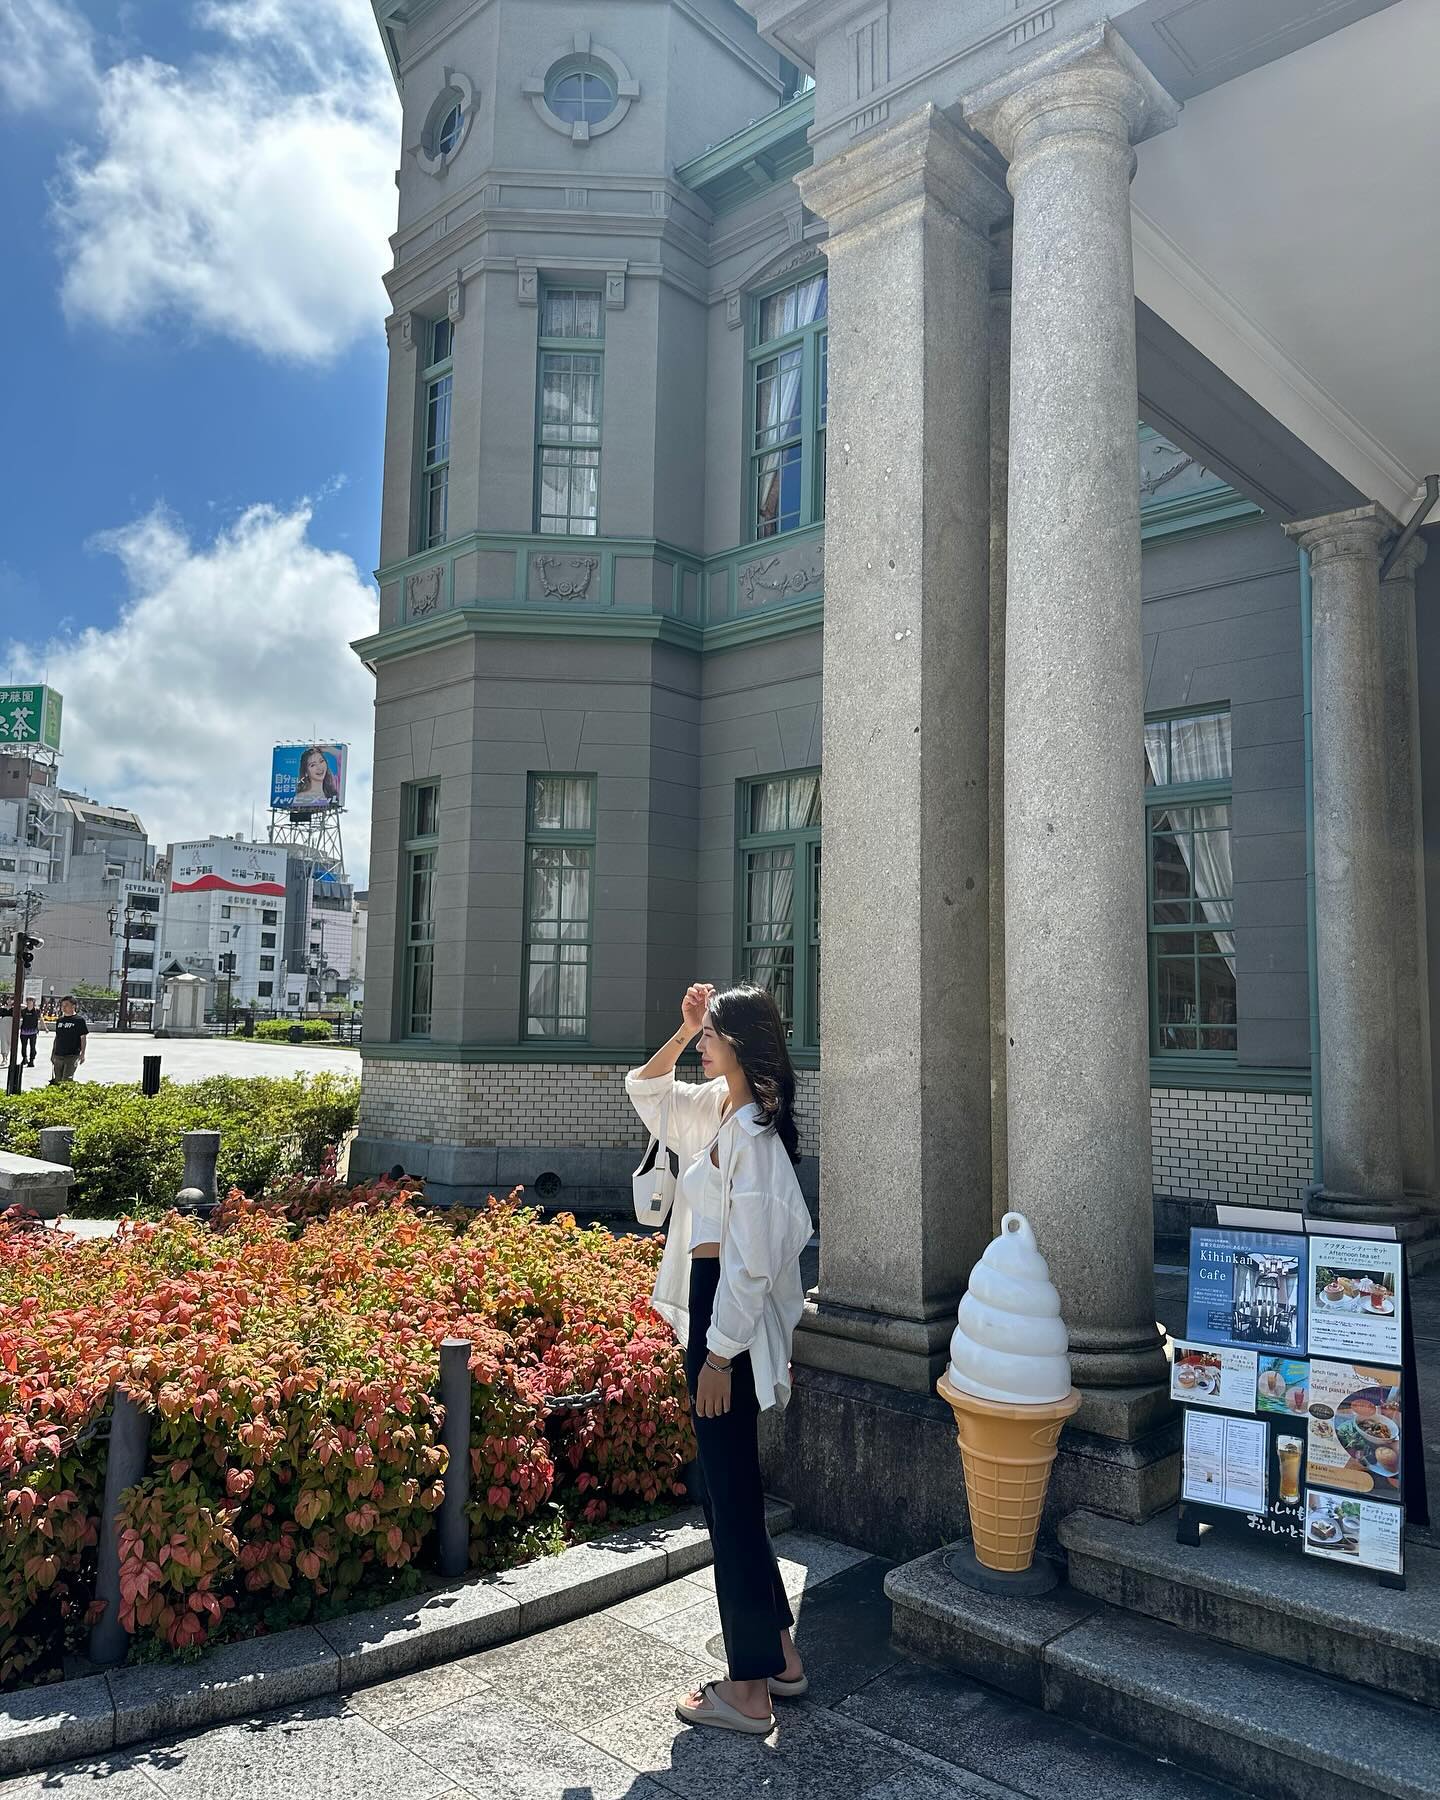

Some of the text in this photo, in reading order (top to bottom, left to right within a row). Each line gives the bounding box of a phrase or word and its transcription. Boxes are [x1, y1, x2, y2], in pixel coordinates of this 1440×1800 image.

[124, 883, 146, 892] SEVEN
[232, 925, 241, 938] 7
[1200, 1249, 1253, 1265] Kihinkan
[1329, 1250, 1358, 1258] Afternoon
[1199, 1268, 1226, 1281] Cafe
[1311, 1383, 1328, 1391] Short
[1328, 1386, 1346, 1394] pasta
